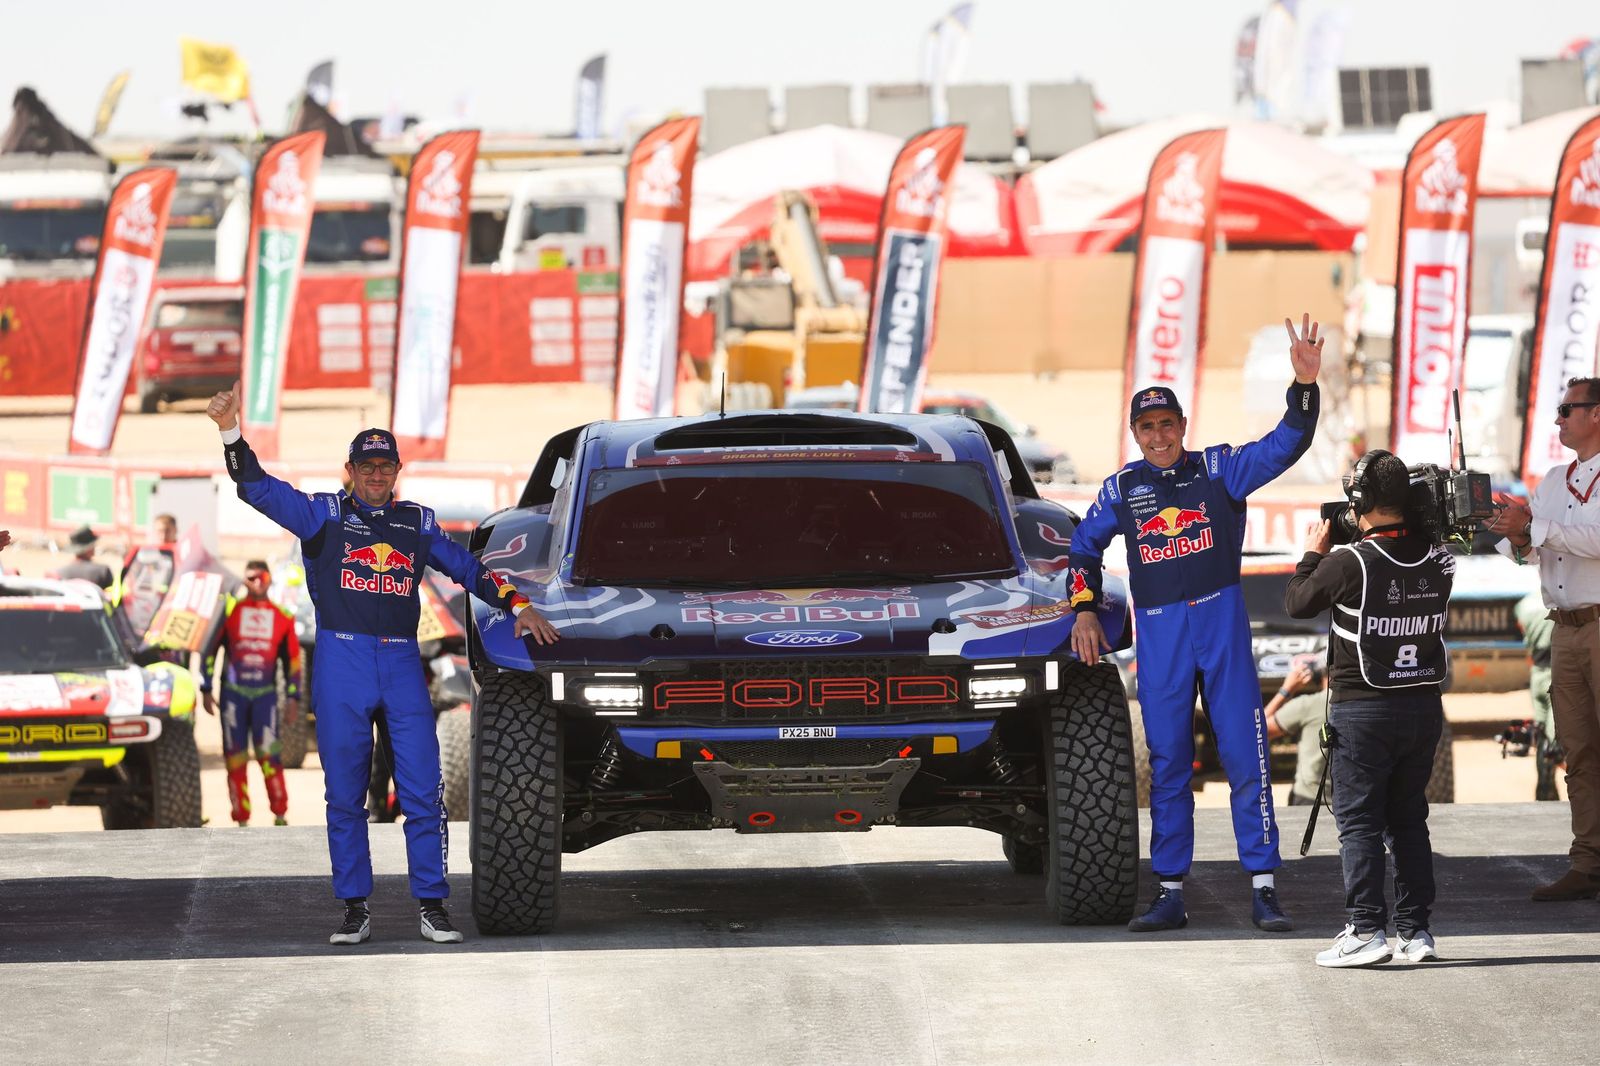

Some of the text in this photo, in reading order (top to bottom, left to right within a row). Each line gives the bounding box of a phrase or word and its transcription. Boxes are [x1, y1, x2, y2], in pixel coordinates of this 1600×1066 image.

[1409, 268, 1455, 430] MOTUL
[363, 442, 390, 450] Red Bull
[1139, 538, 1177, 564] Red
[1176, 527, 1214, 557] Bull
[341, 569, 413, 597] Red Bull
[1197, 592, 1220, 604] ROMA
[681, 602, 921, 624] Red Bull
[1450, 607, 1508, 631] MINI
[767, 630, 840, 645] Ford
[1366, 616, 1429, 637] PODIUM
[1394, 644, 1418, 668] 8
[1389, 668, 1436, 679] #Dakar2026
[654, 676, 958, 710] FORD
[782, 727, 835, 738] PX25 BNU
[1254, 708, 1268, 788] RACING
